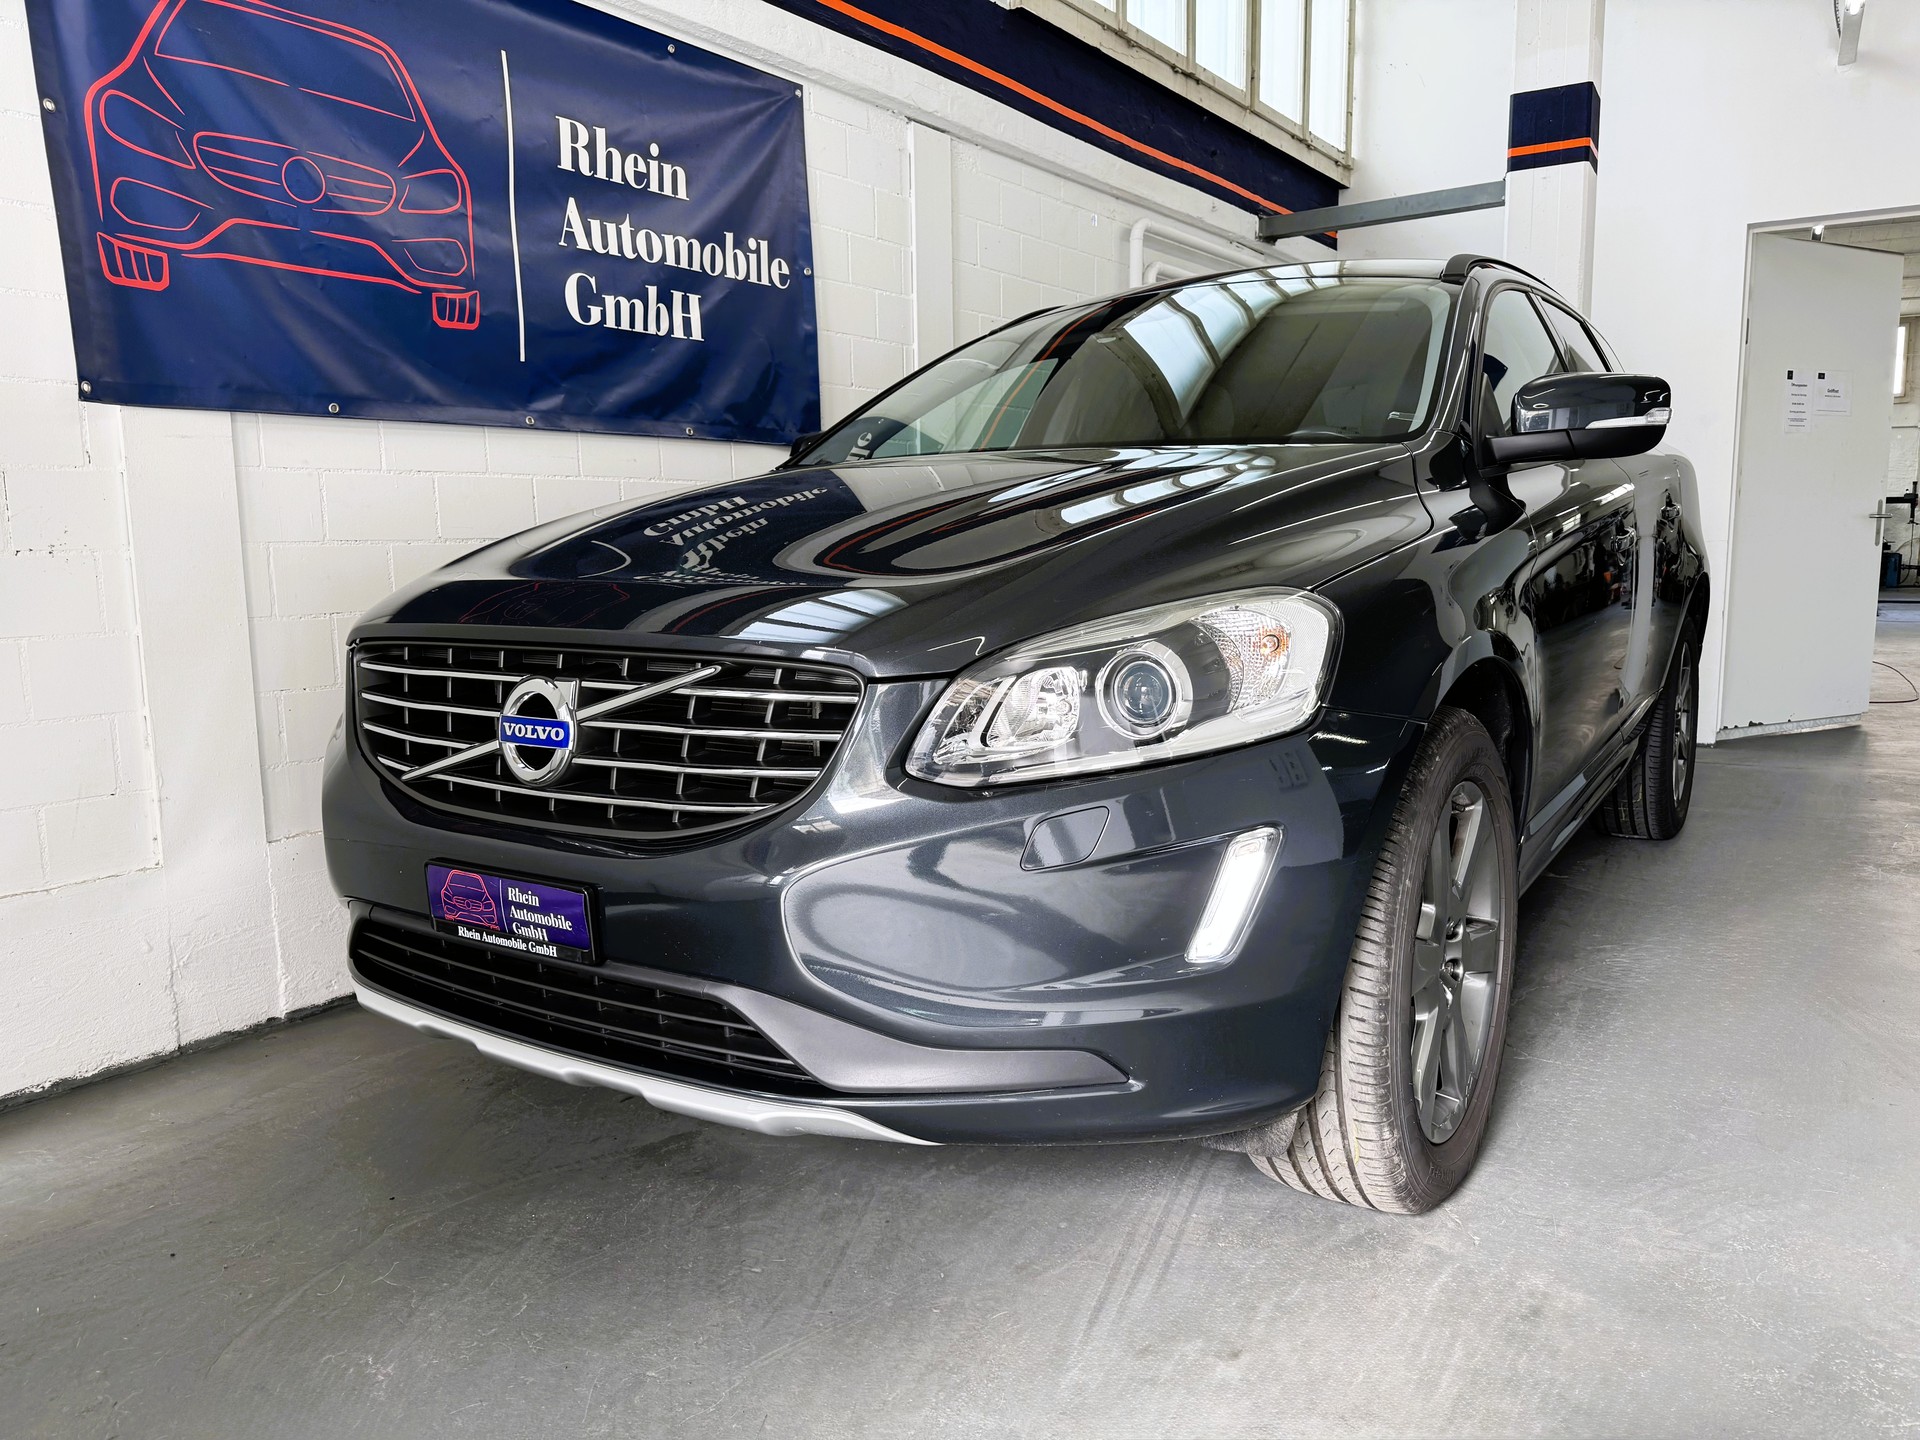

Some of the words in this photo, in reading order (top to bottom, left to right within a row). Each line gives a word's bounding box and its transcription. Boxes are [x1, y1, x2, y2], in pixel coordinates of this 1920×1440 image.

[555, 115, 690, 201] Rhein
[558, 196, 791, 290] Automobile
[564, 271, 705, 342] GmbH
[503, 722, 565, 741] VOLVO
[507, 886, 540, 907] Rhein
[509, 905, 573, 931] Automobile
[512, 922, 549, 942] GmbH
[458, 925, 481, 941] Rhein
[482, 931, 528, 951] Automobile
[528, 941, 558, 958] GmbH
